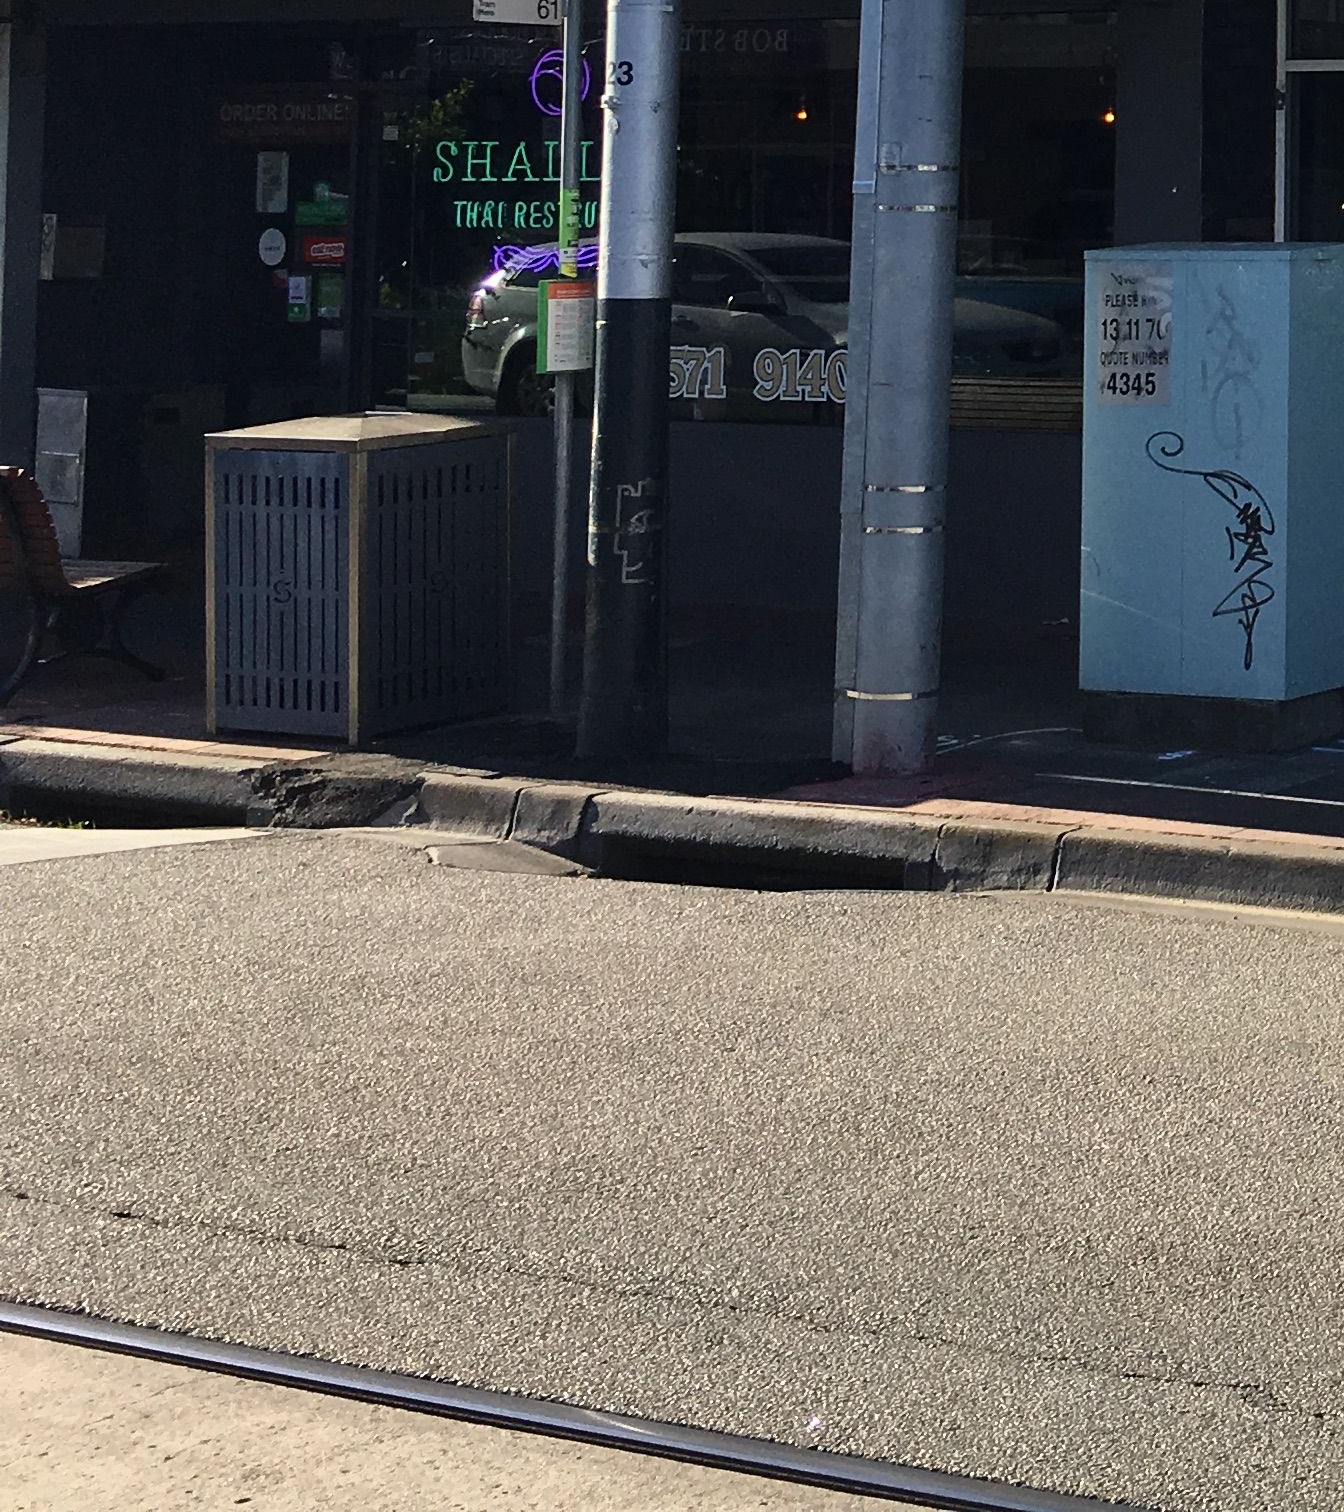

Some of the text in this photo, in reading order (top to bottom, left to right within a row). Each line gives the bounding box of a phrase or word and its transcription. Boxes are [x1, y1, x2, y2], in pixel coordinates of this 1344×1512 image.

[219, 103, 278, 121] ORDER
[1105, 294, 1139, 307] PLEASE
[1101, 318, 1120, 341] 13
[1126, 318, 1140, 341] 11
[1100, 350, 1169, 366] QUOTE NUMBER
[752, 347, 849, 404] 9140
[1107, 372, 1156, 396] 4345
